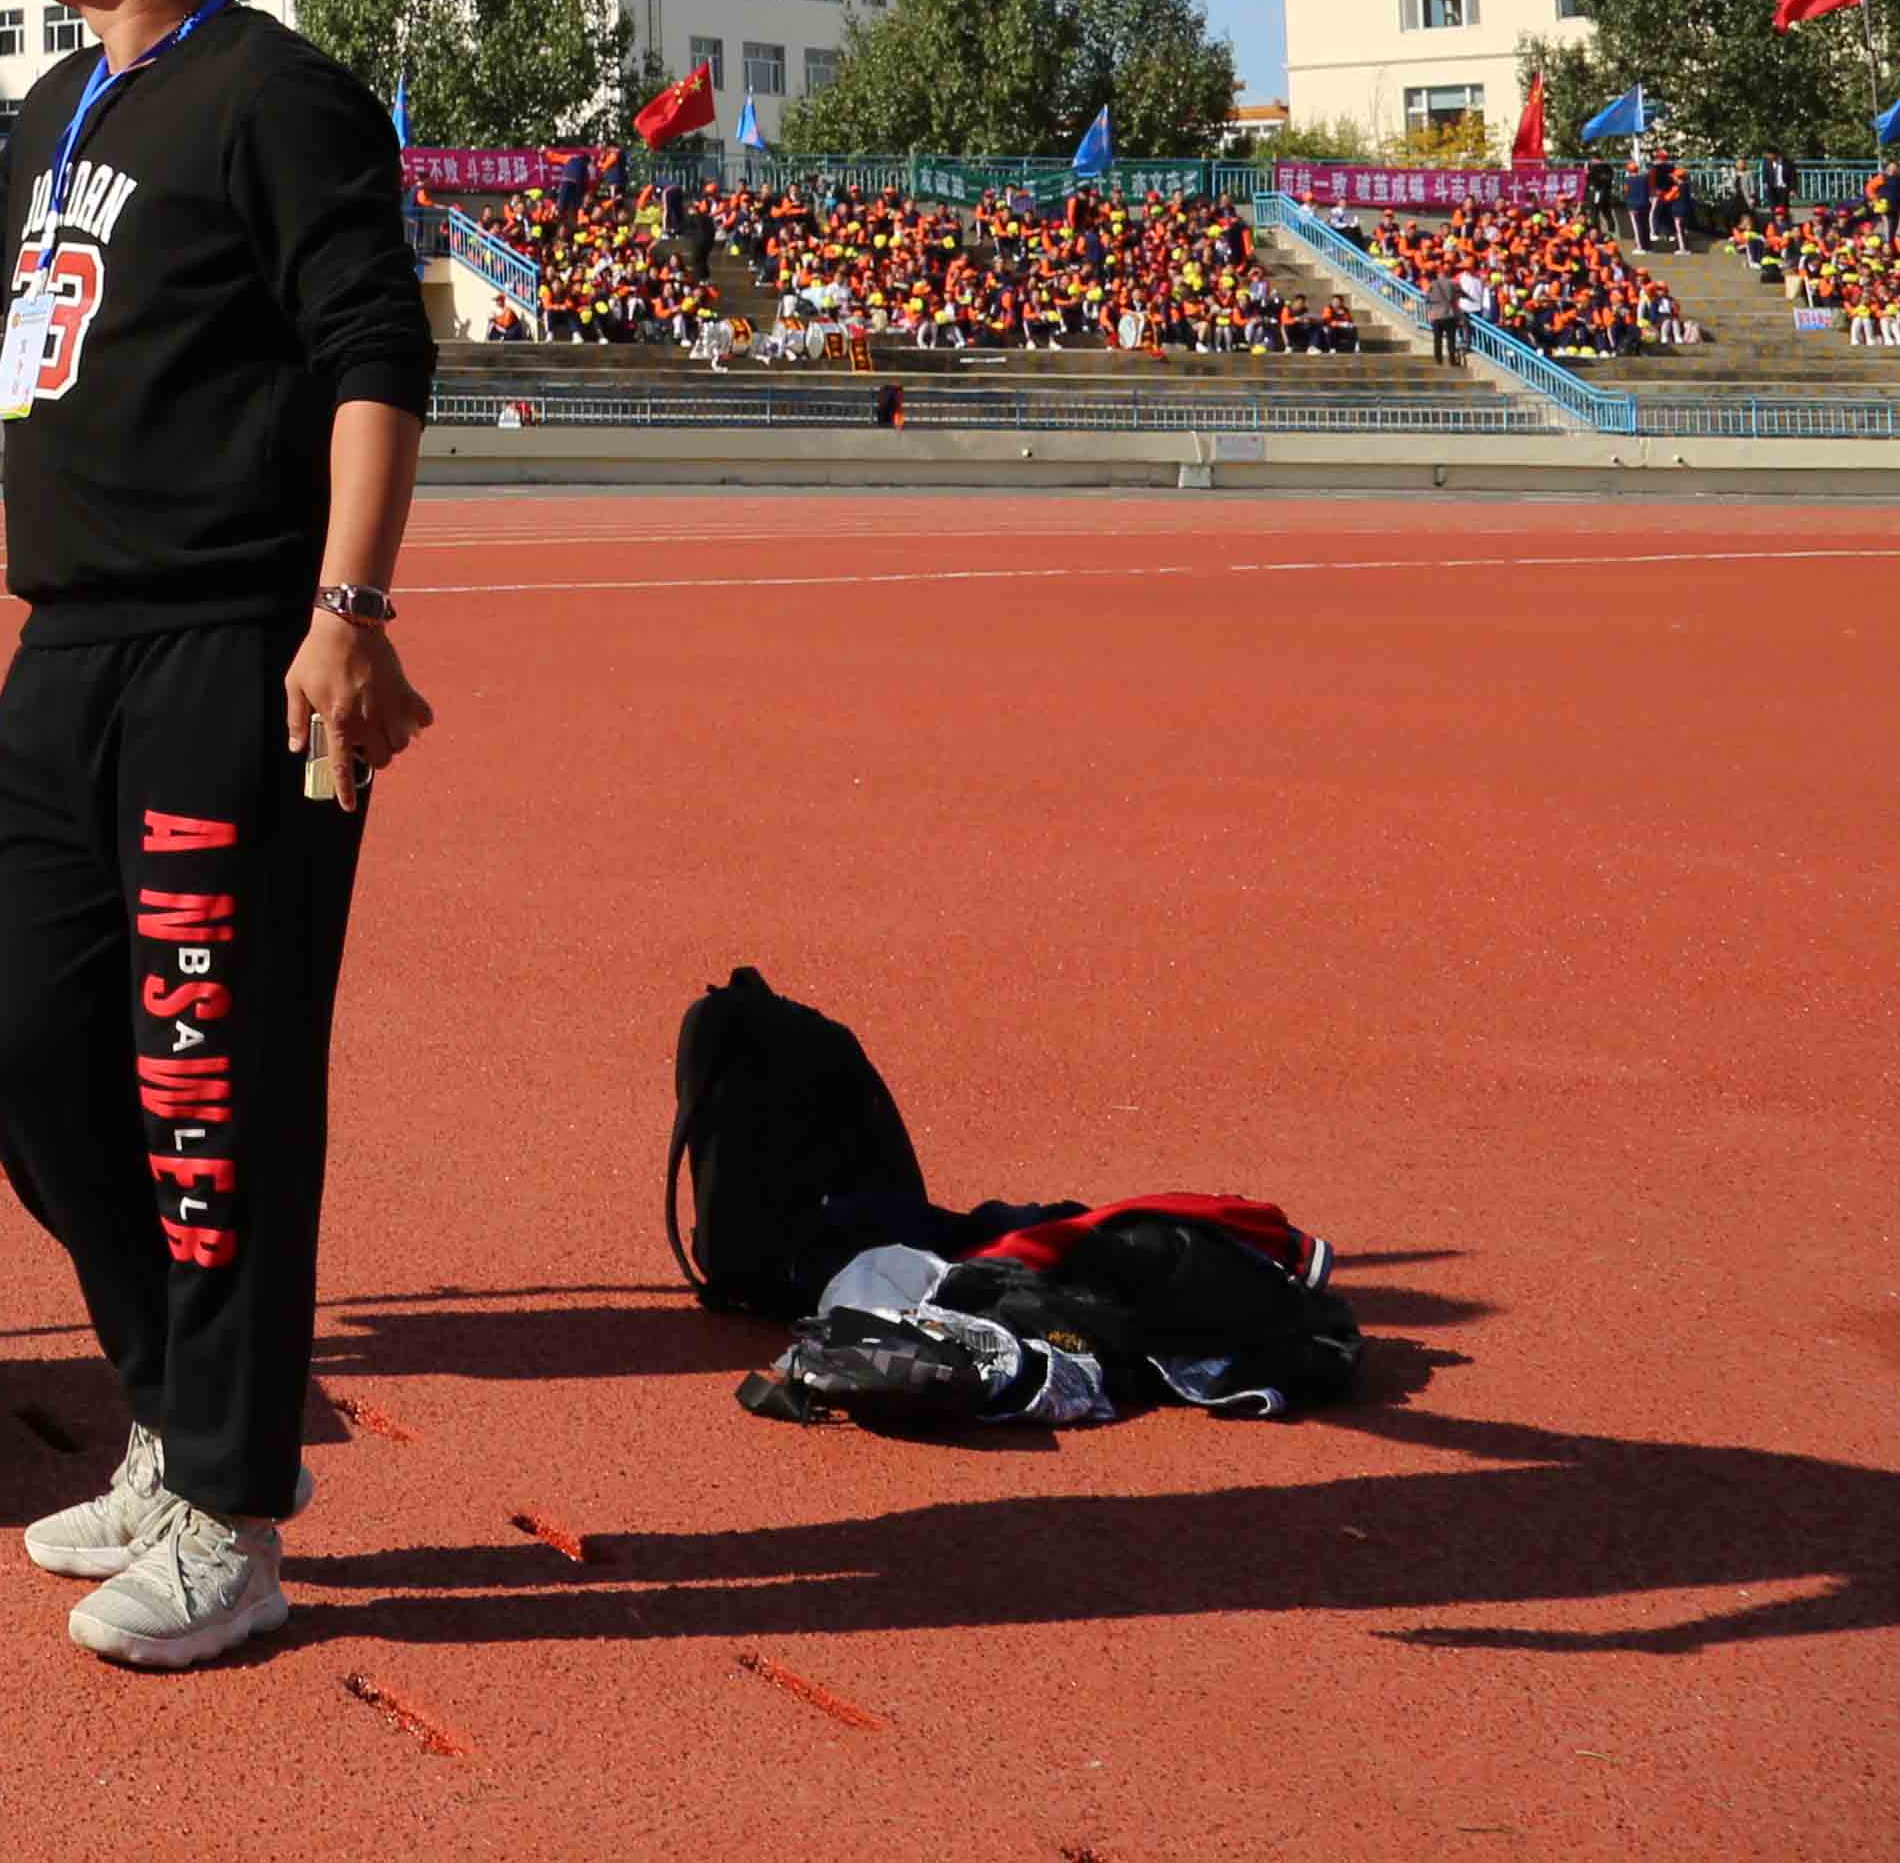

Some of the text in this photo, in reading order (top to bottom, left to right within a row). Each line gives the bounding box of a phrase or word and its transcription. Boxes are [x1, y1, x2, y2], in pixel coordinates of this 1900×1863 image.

[22, 160, 138, 246] JODAN
[1279, 168, 1348, 199] 团结一致
